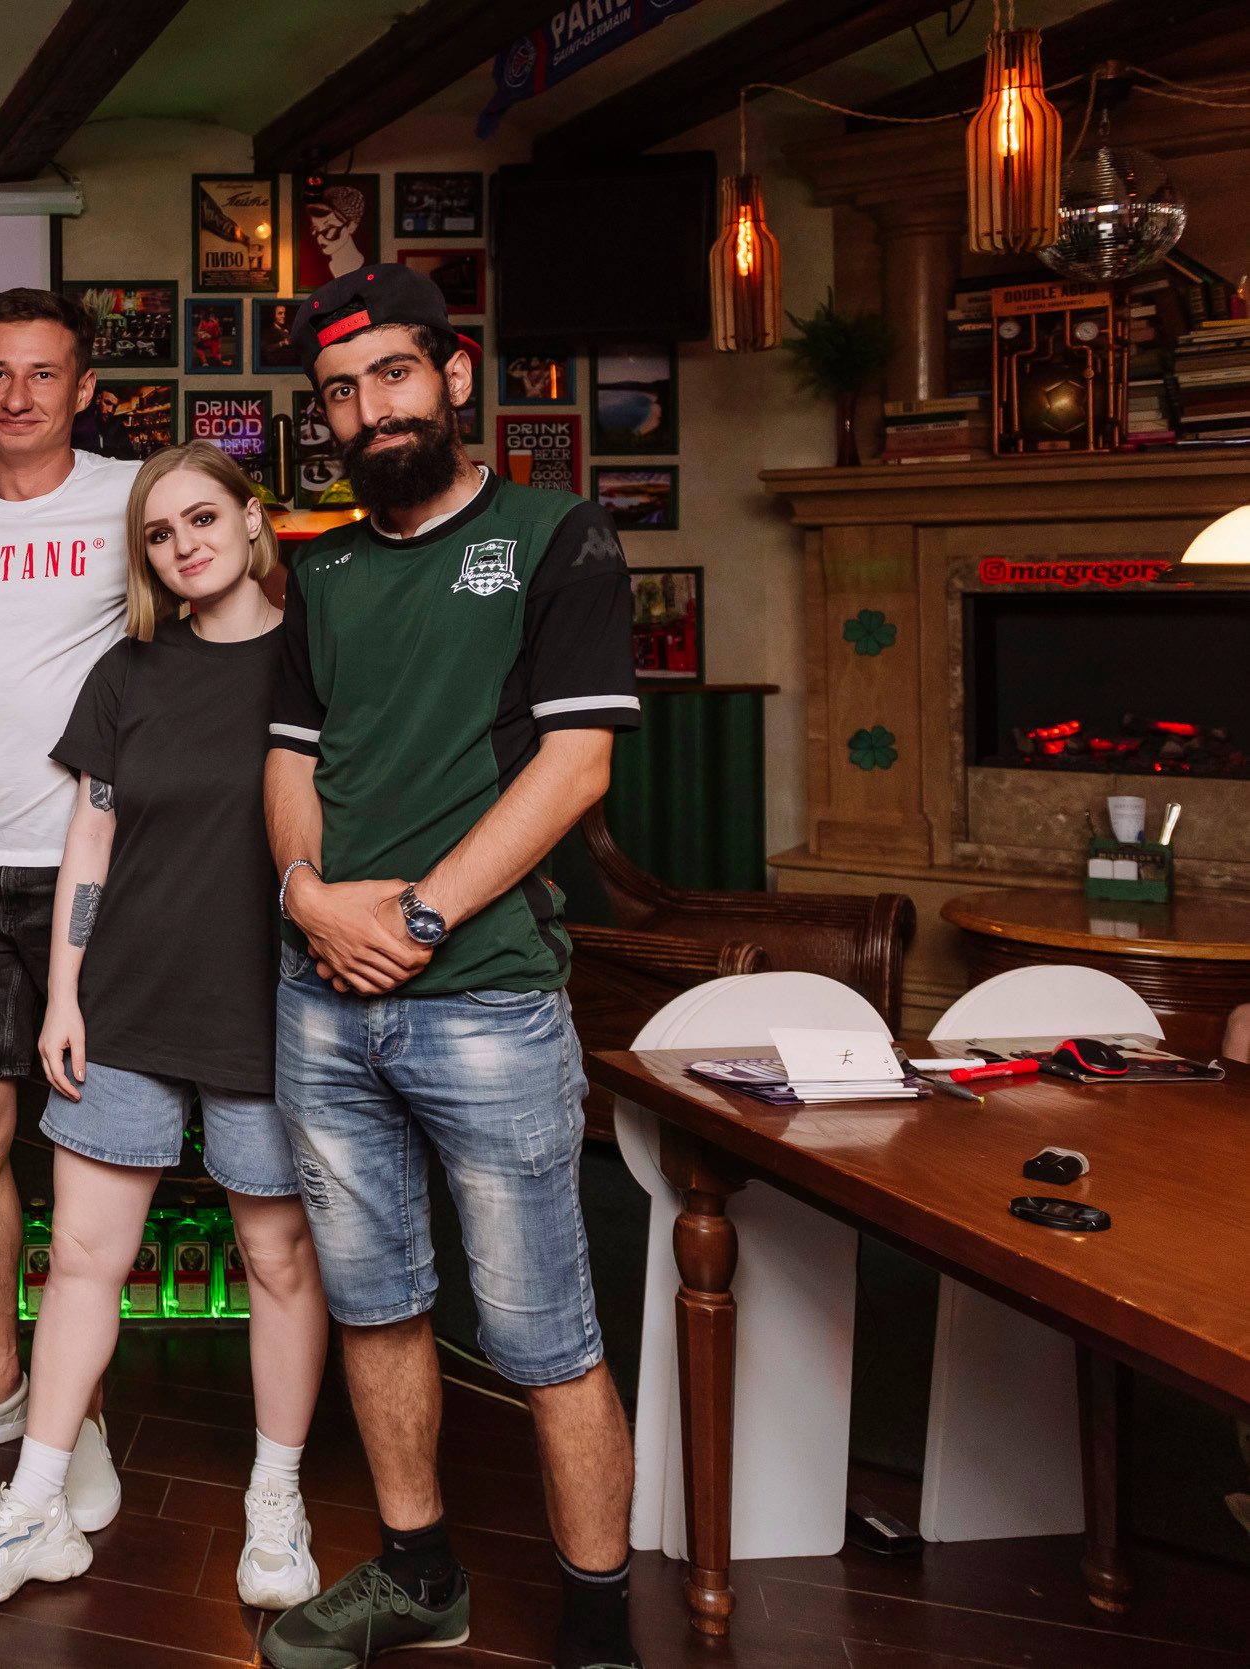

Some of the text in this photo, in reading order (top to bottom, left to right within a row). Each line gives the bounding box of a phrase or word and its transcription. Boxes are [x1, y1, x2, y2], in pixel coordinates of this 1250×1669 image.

[551, 0, 630, 49] PARI
[553, 6, 631, 66] SAINT-GERMAIN
[206, 251, 243, 268] ПИВО
[1004, 286, 1057, 304] DOUBLE
[195, 400, 262, 416] DRINK
[195, 418, 262, 436] GOOD
[507, 423, 570, 434] DRINK
[223, 438, 263, 454] BEER
[507, 435, 571, 448] GOOD
[534, 449, 571, 460] BEER
[532, 470, 572, 480] GOOD
